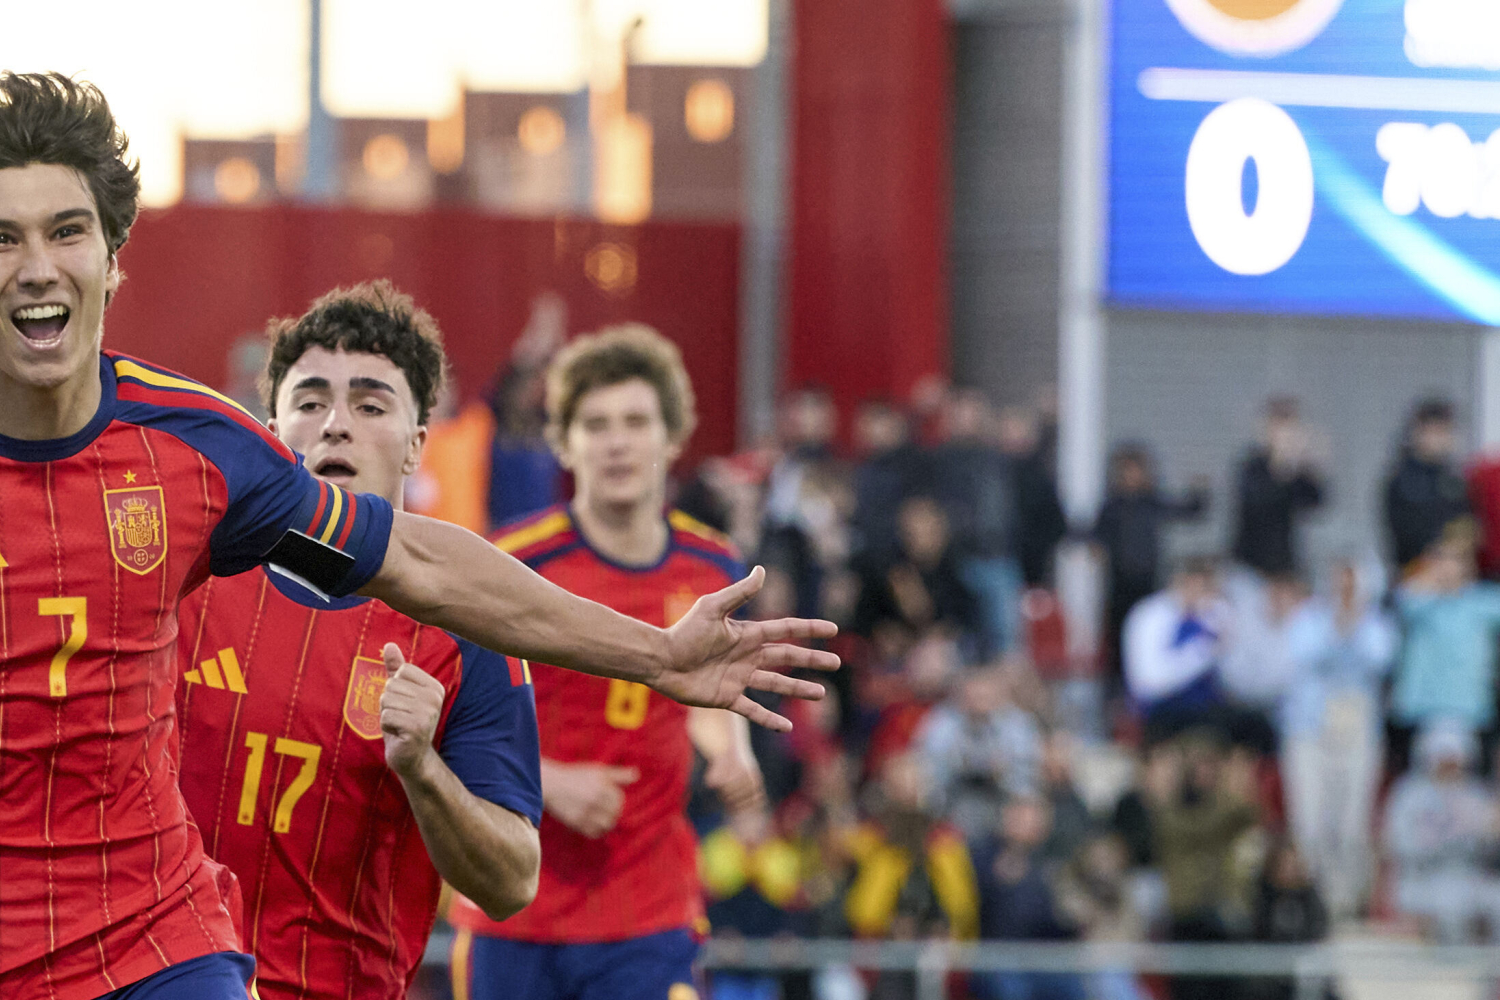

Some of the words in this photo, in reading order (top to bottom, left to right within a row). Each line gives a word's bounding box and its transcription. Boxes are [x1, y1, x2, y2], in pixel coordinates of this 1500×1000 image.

[1185, 99, 1314, 276] 0
[38, 596, 87, 697] 7
[237, 731, 322, 834] 17
